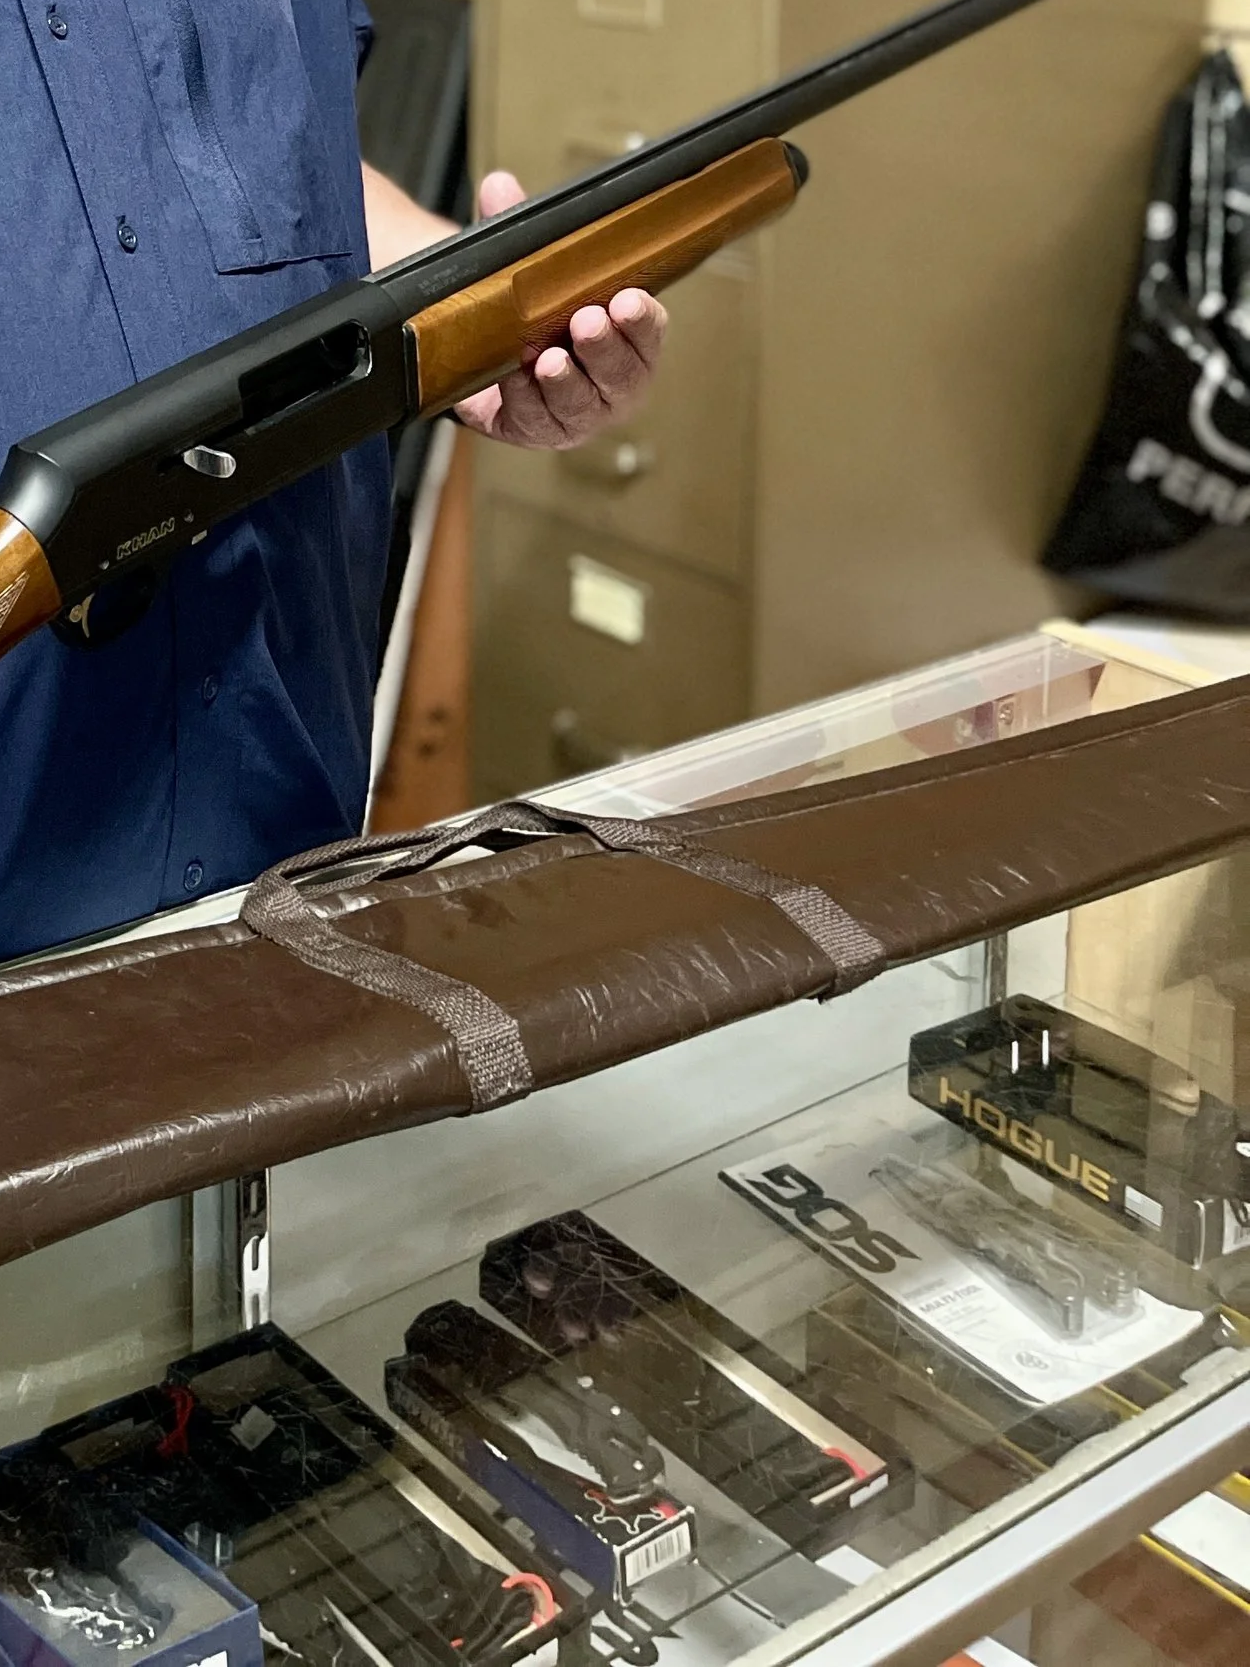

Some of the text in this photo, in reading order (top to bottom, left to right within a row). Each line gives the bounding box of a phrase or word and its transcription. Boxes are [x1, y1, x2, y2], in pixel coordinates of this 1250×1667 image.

[116, 517, 176, 560] KHAN
[939, 1076, 1113, 1203] HOGUE
[745, 1162, 923, 1274] SOG
